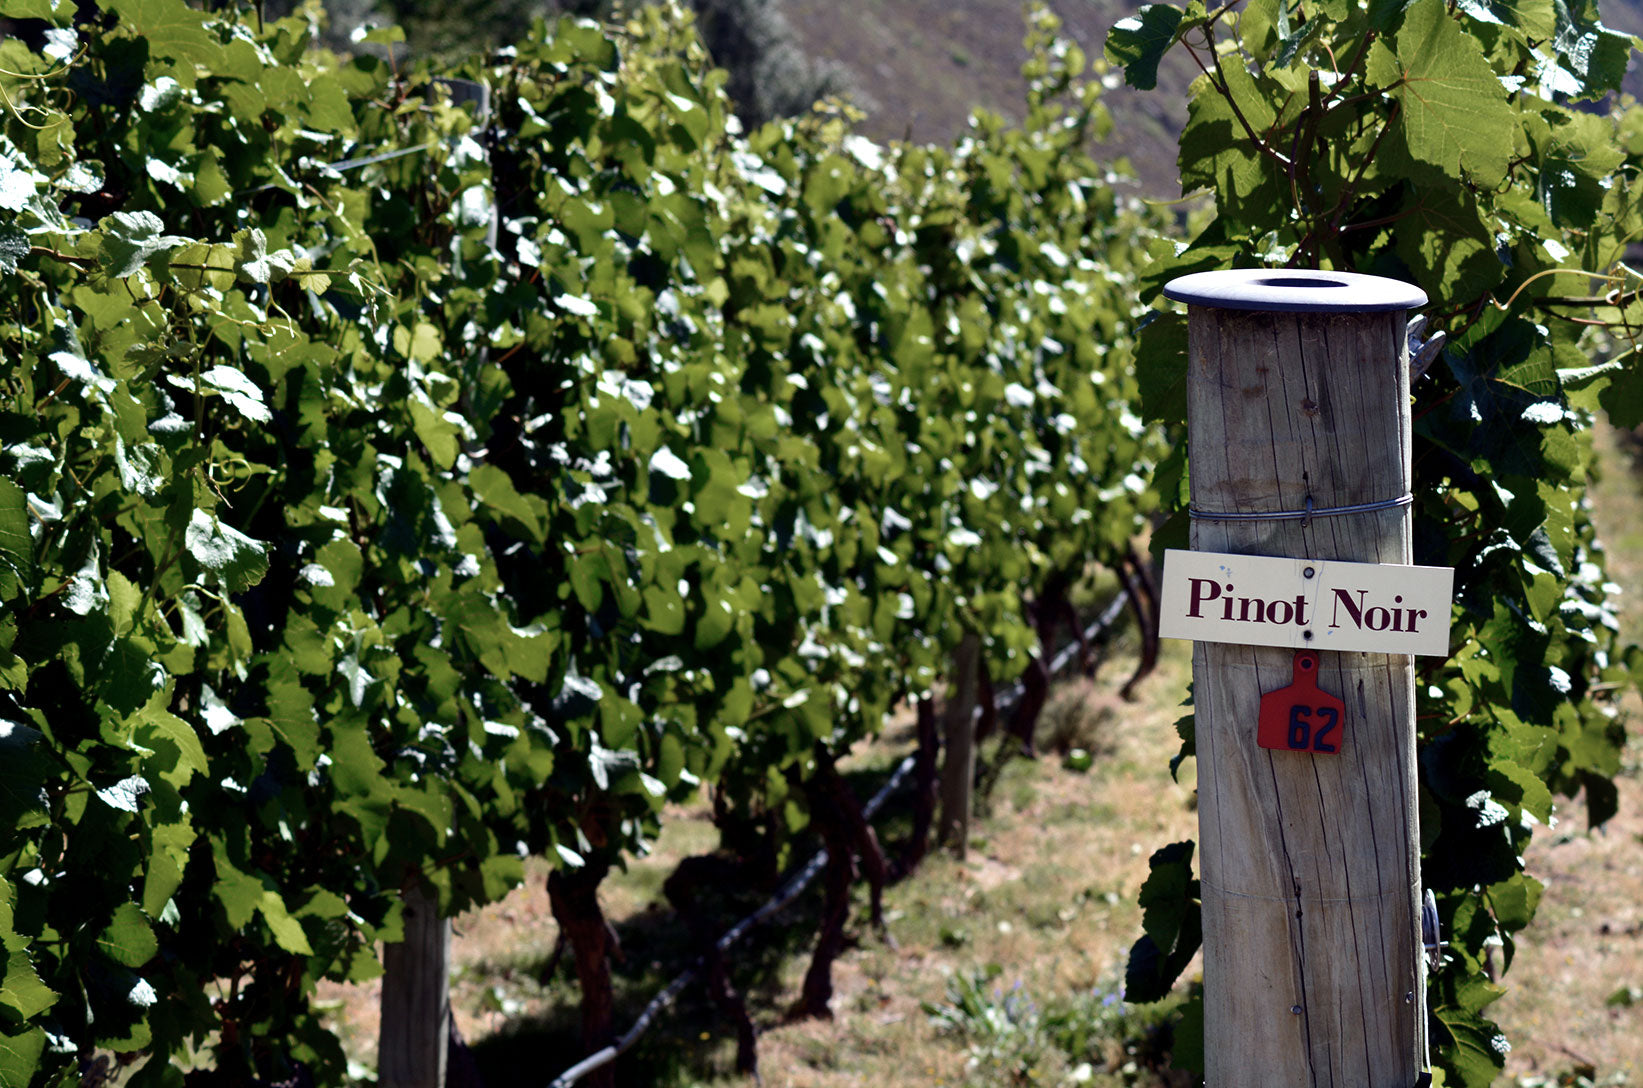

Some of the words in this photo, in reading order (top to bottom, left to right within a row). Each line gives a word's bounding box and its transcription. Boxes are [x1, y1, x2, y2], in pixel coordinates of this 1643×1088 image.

[1185, 577, 1310, 626] Pinot
[1328, 587, 1428, 634] Noir
[1288, 705, 1338, 752] 62
